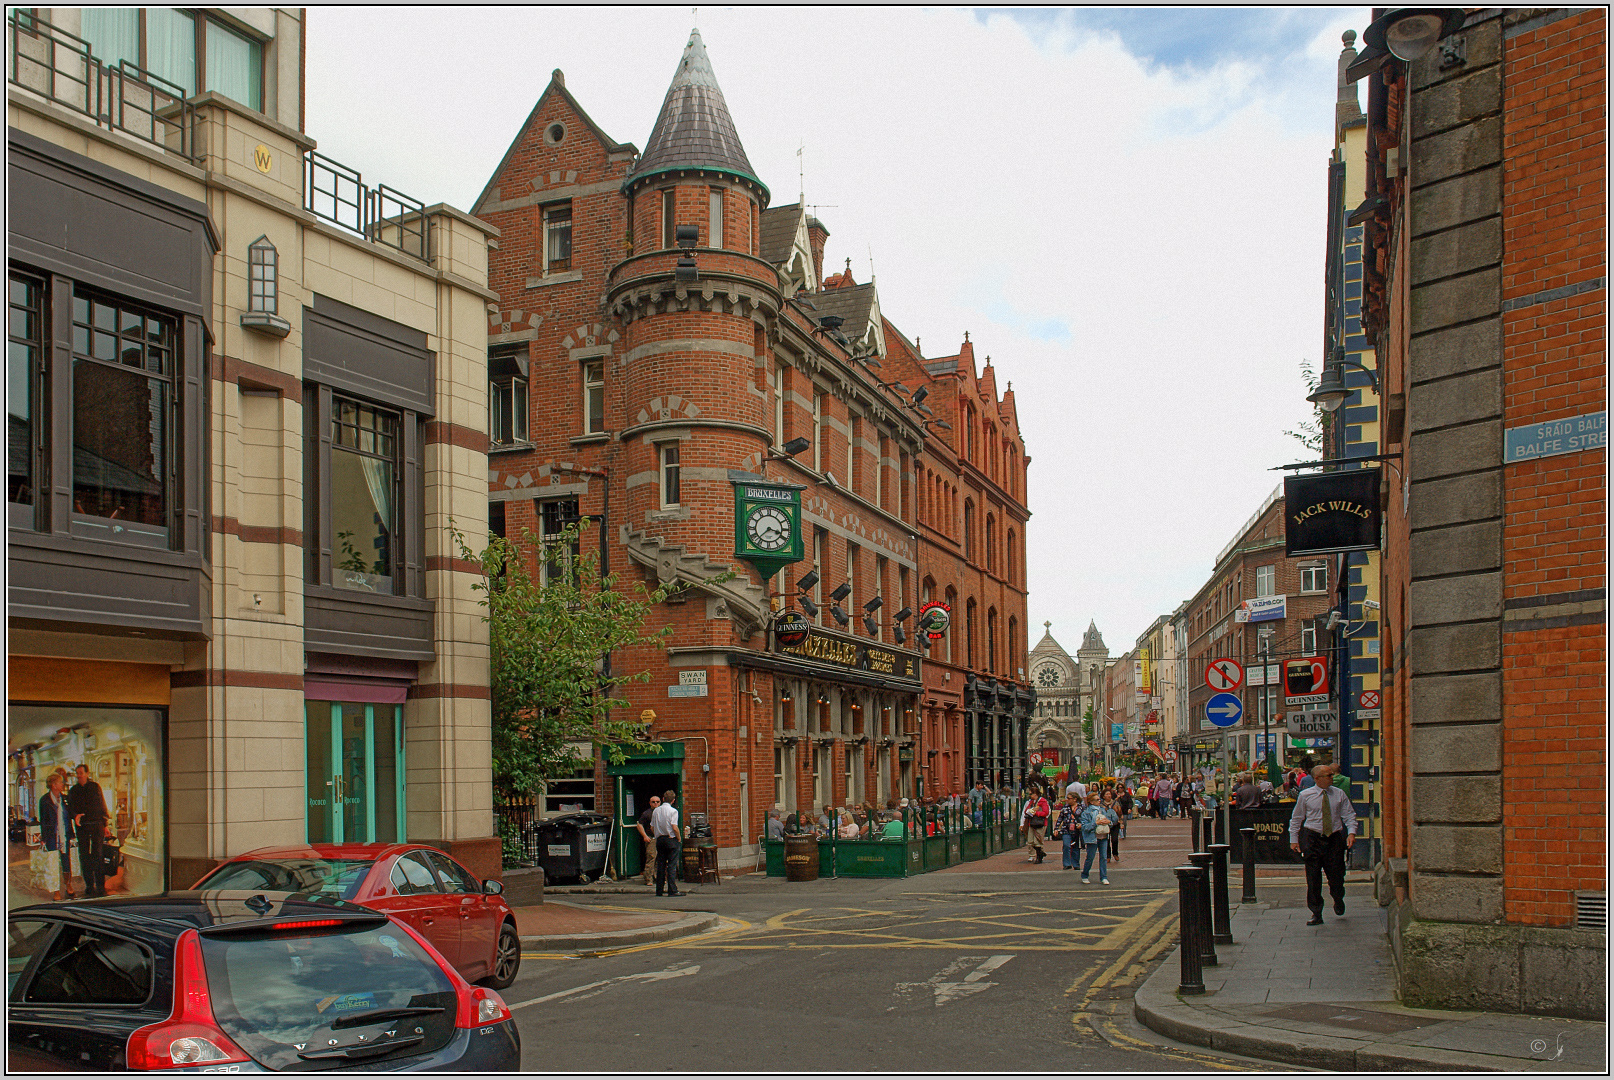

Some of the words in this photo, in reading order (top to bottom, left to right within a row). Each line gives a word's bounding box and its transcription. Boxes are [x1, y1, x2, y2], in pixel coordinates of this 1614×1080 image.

[255, 150, 271, 169] W
[1538, 423, 1572, 439] SRÁID
[1516, 440, 1562, 457] BALFE
[747, 488, 792, 500] BRUXELLES
[1293, 503, 1327, 525] JACK
[1328, 501, 1372, 519] WILLS
[776, 623, 808, 632] GUINNESS
[1288, 695, 1327, 704] GUINNESS
[1300, 723, 1331, 732] HOUSE
[294, 1027, 424, 1051] VOLVO
